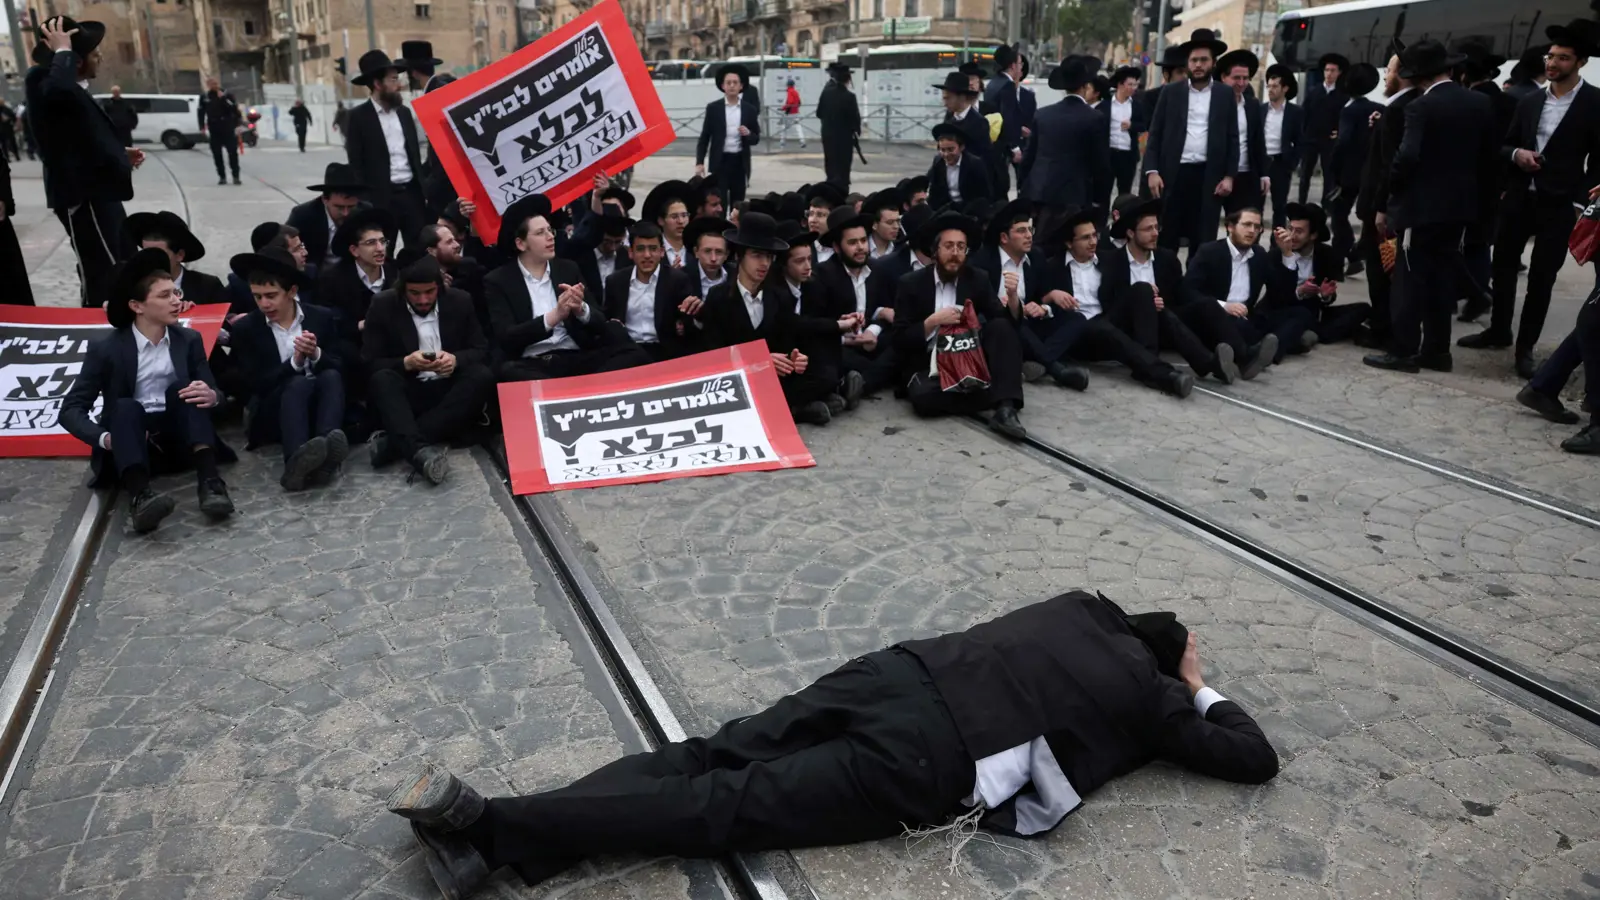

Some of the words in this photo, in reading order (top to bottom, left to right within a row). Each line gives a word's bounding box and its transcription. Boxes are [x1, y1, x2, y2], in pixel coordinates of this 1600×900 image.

[534, 43, 604, 96] אומרים
[464, 85, 531, 136] לבג"ץ
[587, 110, 638, 156] ולא
[499, 139, 583, 204] לצבא
[552, 400, 635, 432] לבג"ץ
[642, 388, 739, 416] אומרים
[563, 453, 678, 479] לצבא
[688, 444, 766, 466] ולא
